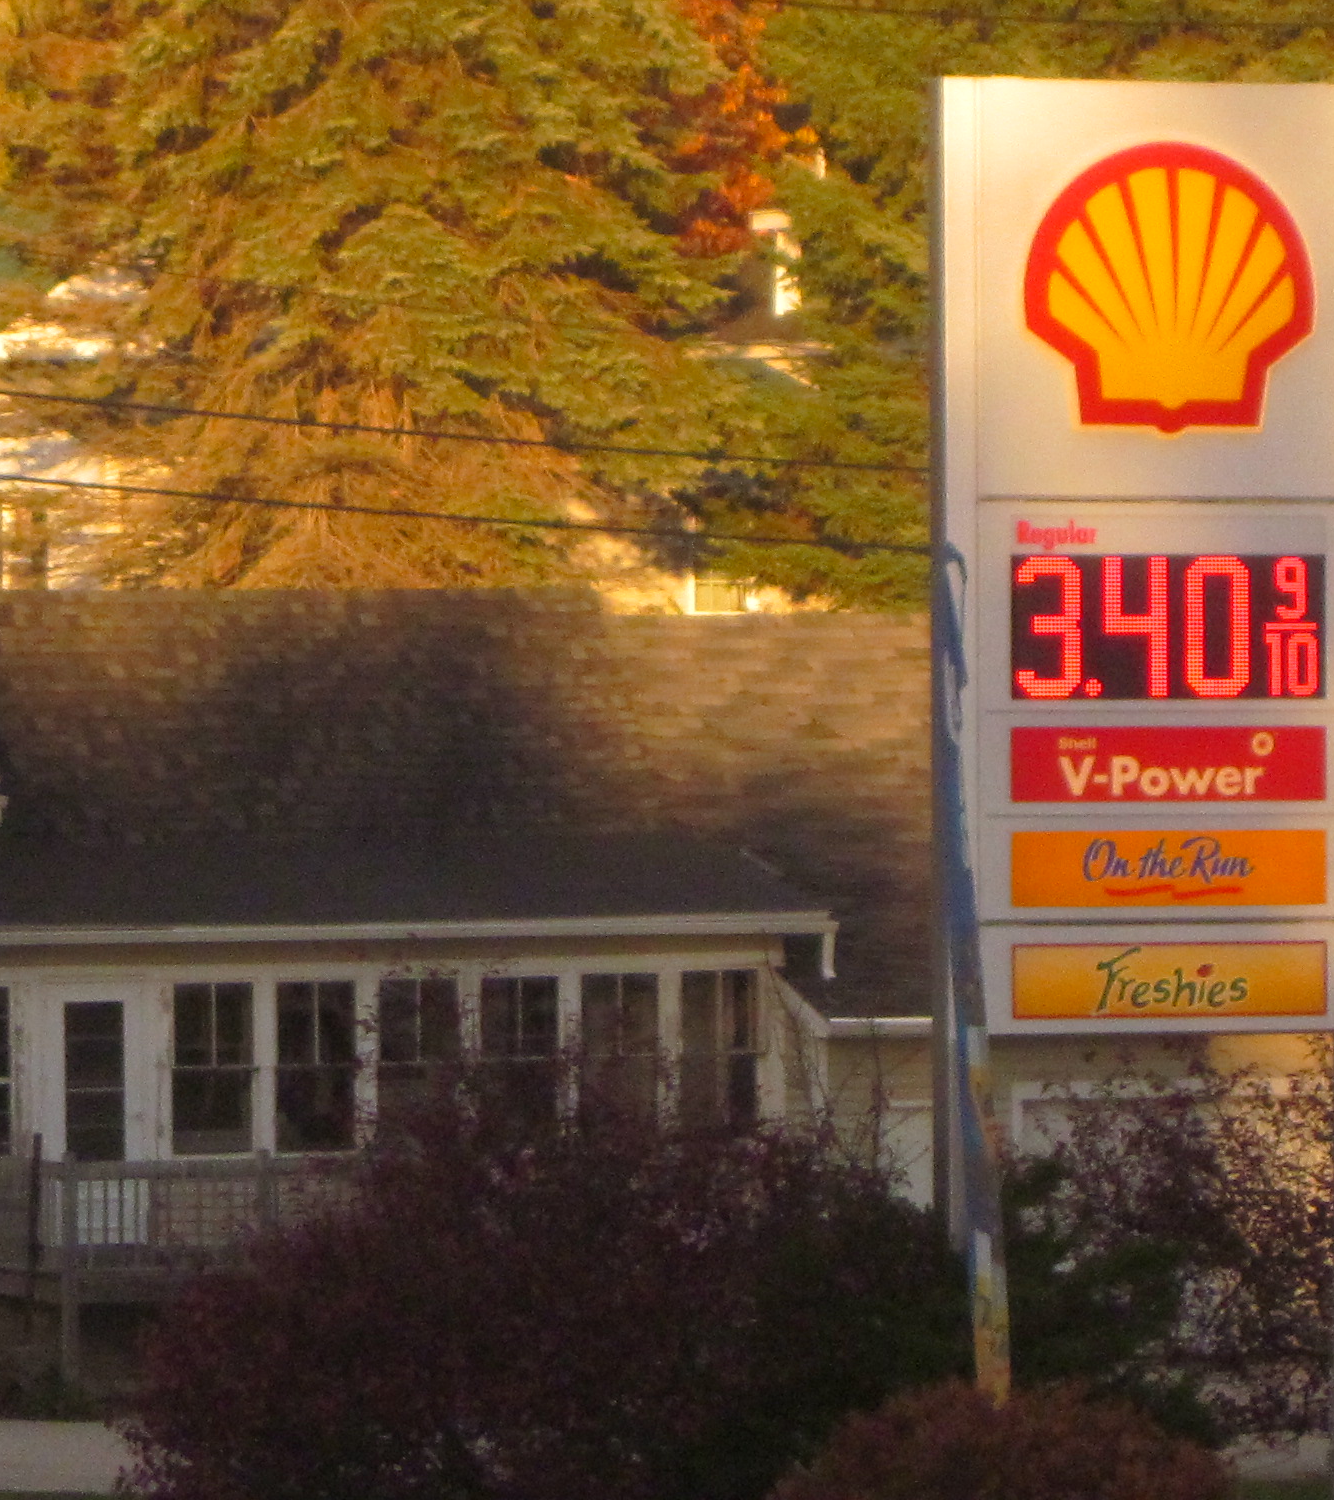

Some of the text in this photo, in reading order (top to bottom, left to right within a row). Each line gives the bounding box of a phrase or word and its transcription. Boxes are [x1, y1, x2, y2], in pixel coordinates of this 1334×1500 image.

[1016, 519, 1097, 550] Regular
[1015, 556, 1251, 697] 3.40
[1059, 756, 1266, 797] V-Power
[1083, 836, 1255, 884] On the Run
[1096, 947, 1249, 1012] Freshies
